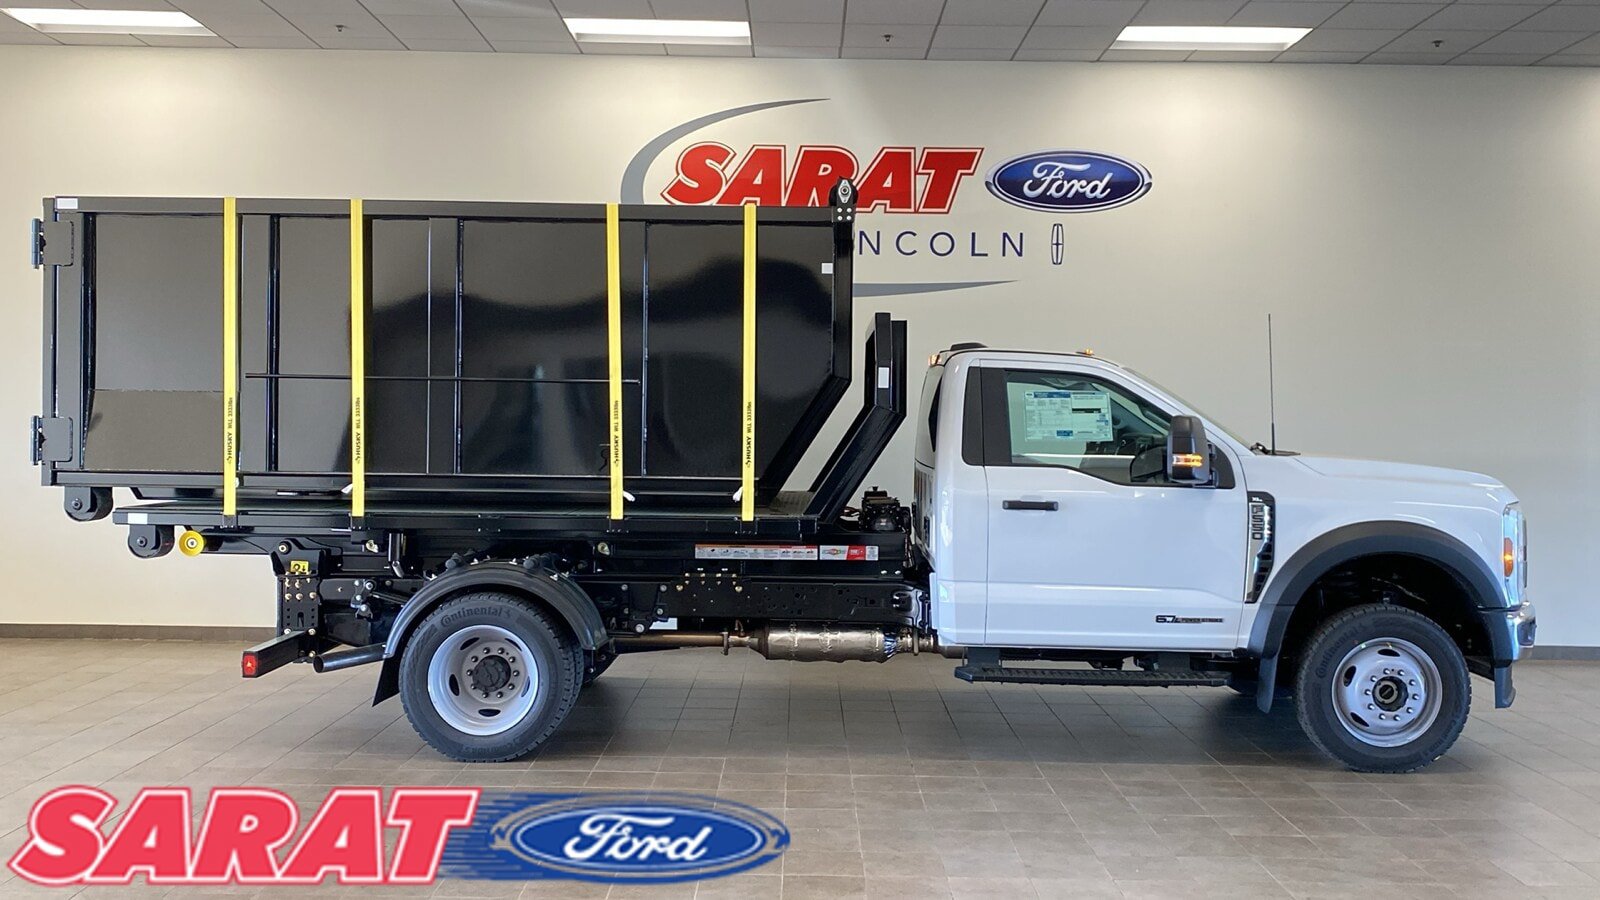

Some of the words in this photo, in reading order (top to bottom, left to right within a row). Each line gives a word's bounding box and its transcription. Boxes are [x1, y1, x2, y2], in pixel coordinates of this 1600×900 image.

[661, 141, 984, 214] SARAT
[1023, 161, 1111, 200] Ford
[858, 230, 1024, 257] NCOLN
[441, 607, 503, 627] Continental
